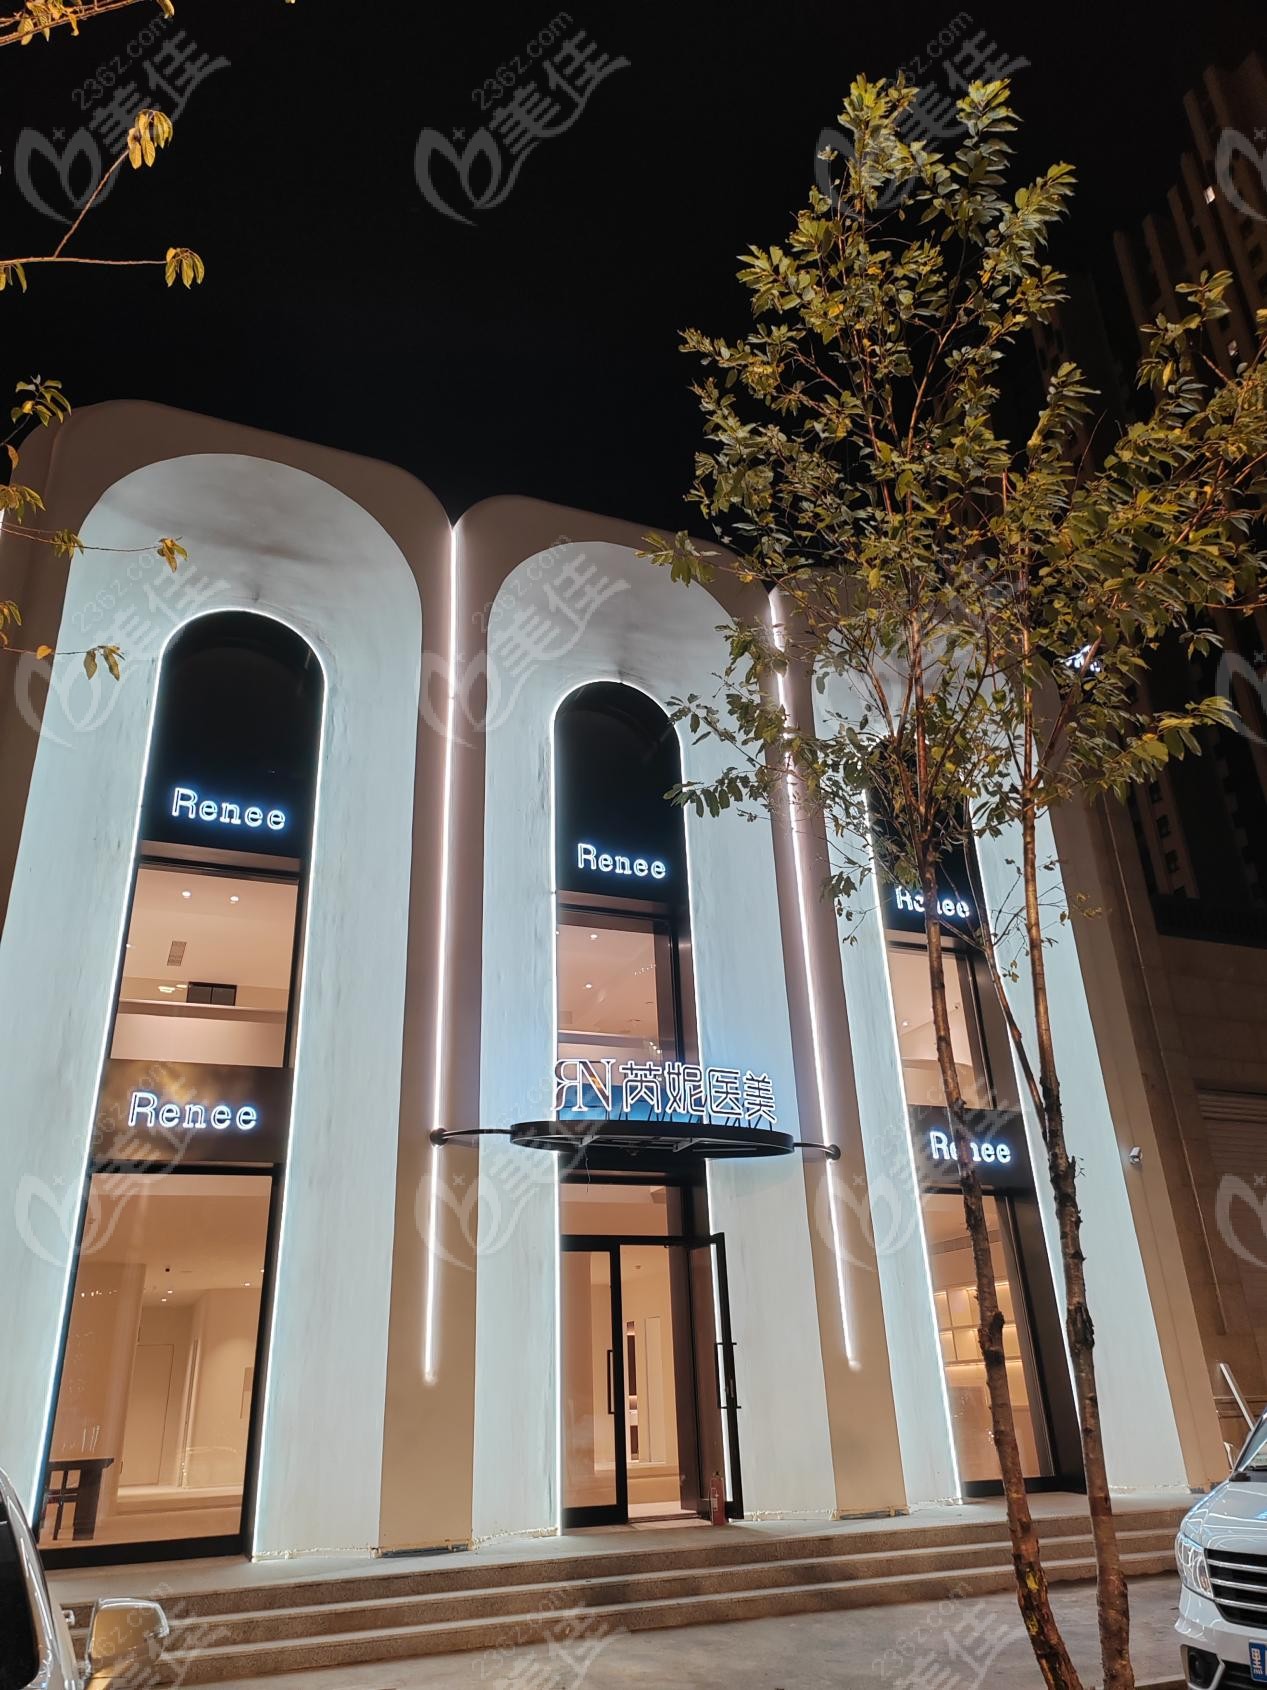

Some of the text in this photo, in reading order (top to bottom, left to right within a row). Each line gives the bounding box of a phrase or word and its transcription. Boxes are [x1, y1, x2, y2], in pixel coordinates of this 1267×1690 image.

[171, 787, 286, 830] Renee
[577, 843, 666, 879] Renee
[127, 1092, 257, 1130] Renee
[619, 1061, 777, 1123] 芮妮医美
